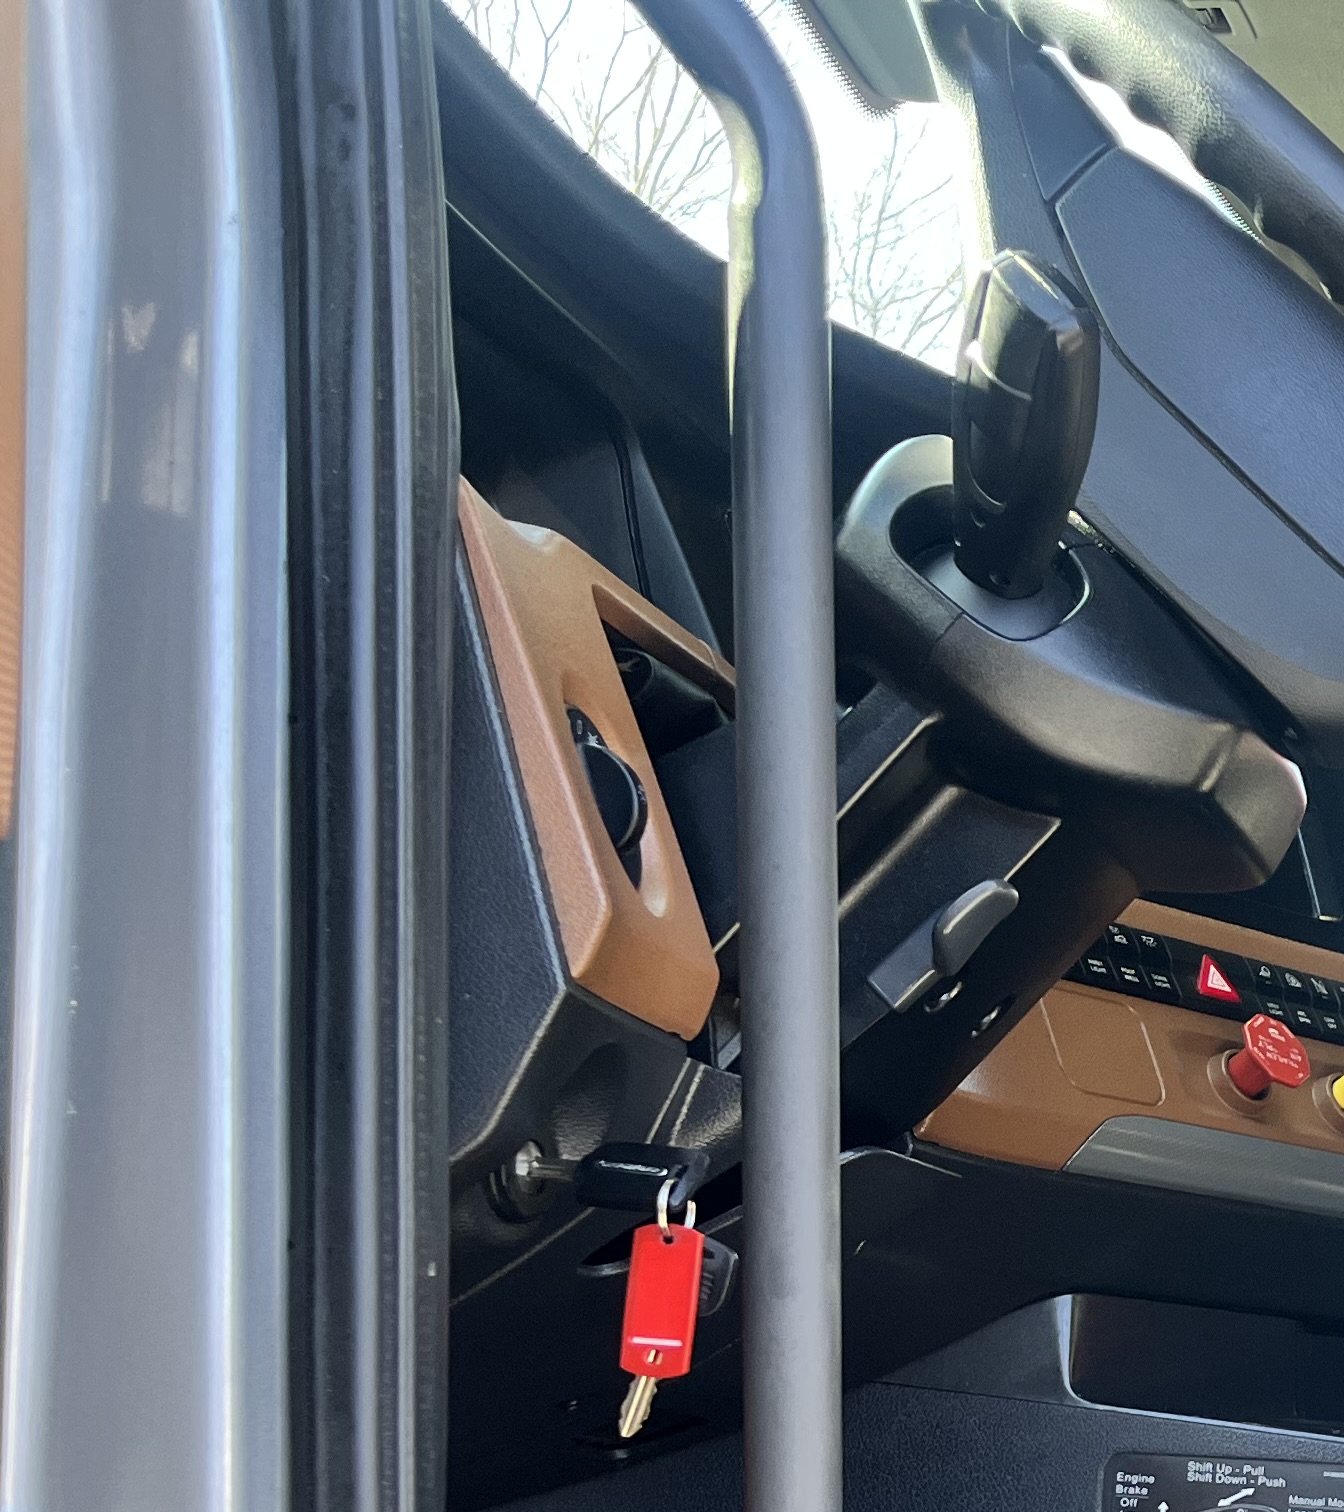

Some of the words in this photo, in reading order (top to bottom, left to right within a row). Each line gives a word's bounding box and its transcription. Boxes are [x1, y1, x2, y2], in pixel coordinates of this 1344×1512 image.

[1187, 1460, 1213, 1472] Shift
[1216, 1463, 1232, 1475] Up
[1243, 1464, 1265, 1476] Pull
[1116, 1471, 1155, 1484] Engine
[1187, 1472, 1213, 1483] Shift
[1216, 1473, 1247, 1484] Down
[1258, 1476, 1286, 1487] Push
[1115, 1484, 1148, 1495] Brake
[1120, 1498, 1138, 1507] Off
[1288, 1495, 1325, 1506] Manual
